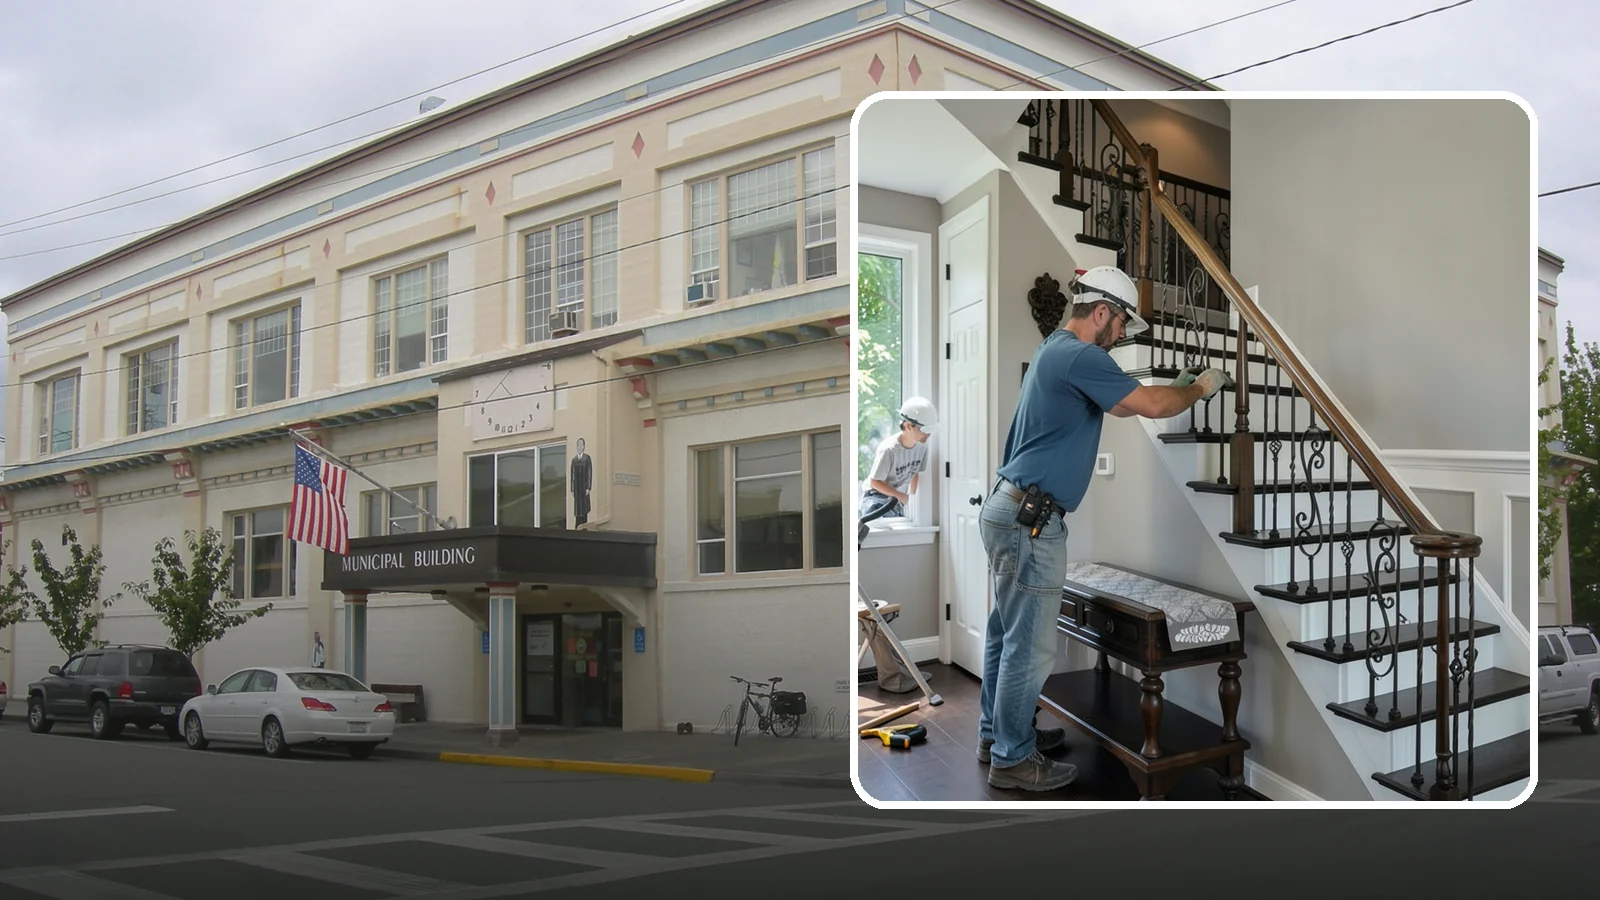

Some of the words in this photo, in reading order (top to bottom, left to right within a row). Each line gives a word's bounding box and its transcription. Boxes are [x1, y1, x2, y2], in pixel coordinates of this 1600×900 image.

[495, 423, 500, 431] 10
[501, 425, 506, 433] 11
[507, 425, 513, 433] 12
[342, 552, 405, 572] MUNICIPAL
[414, 546, 475, 567] BUILDING
